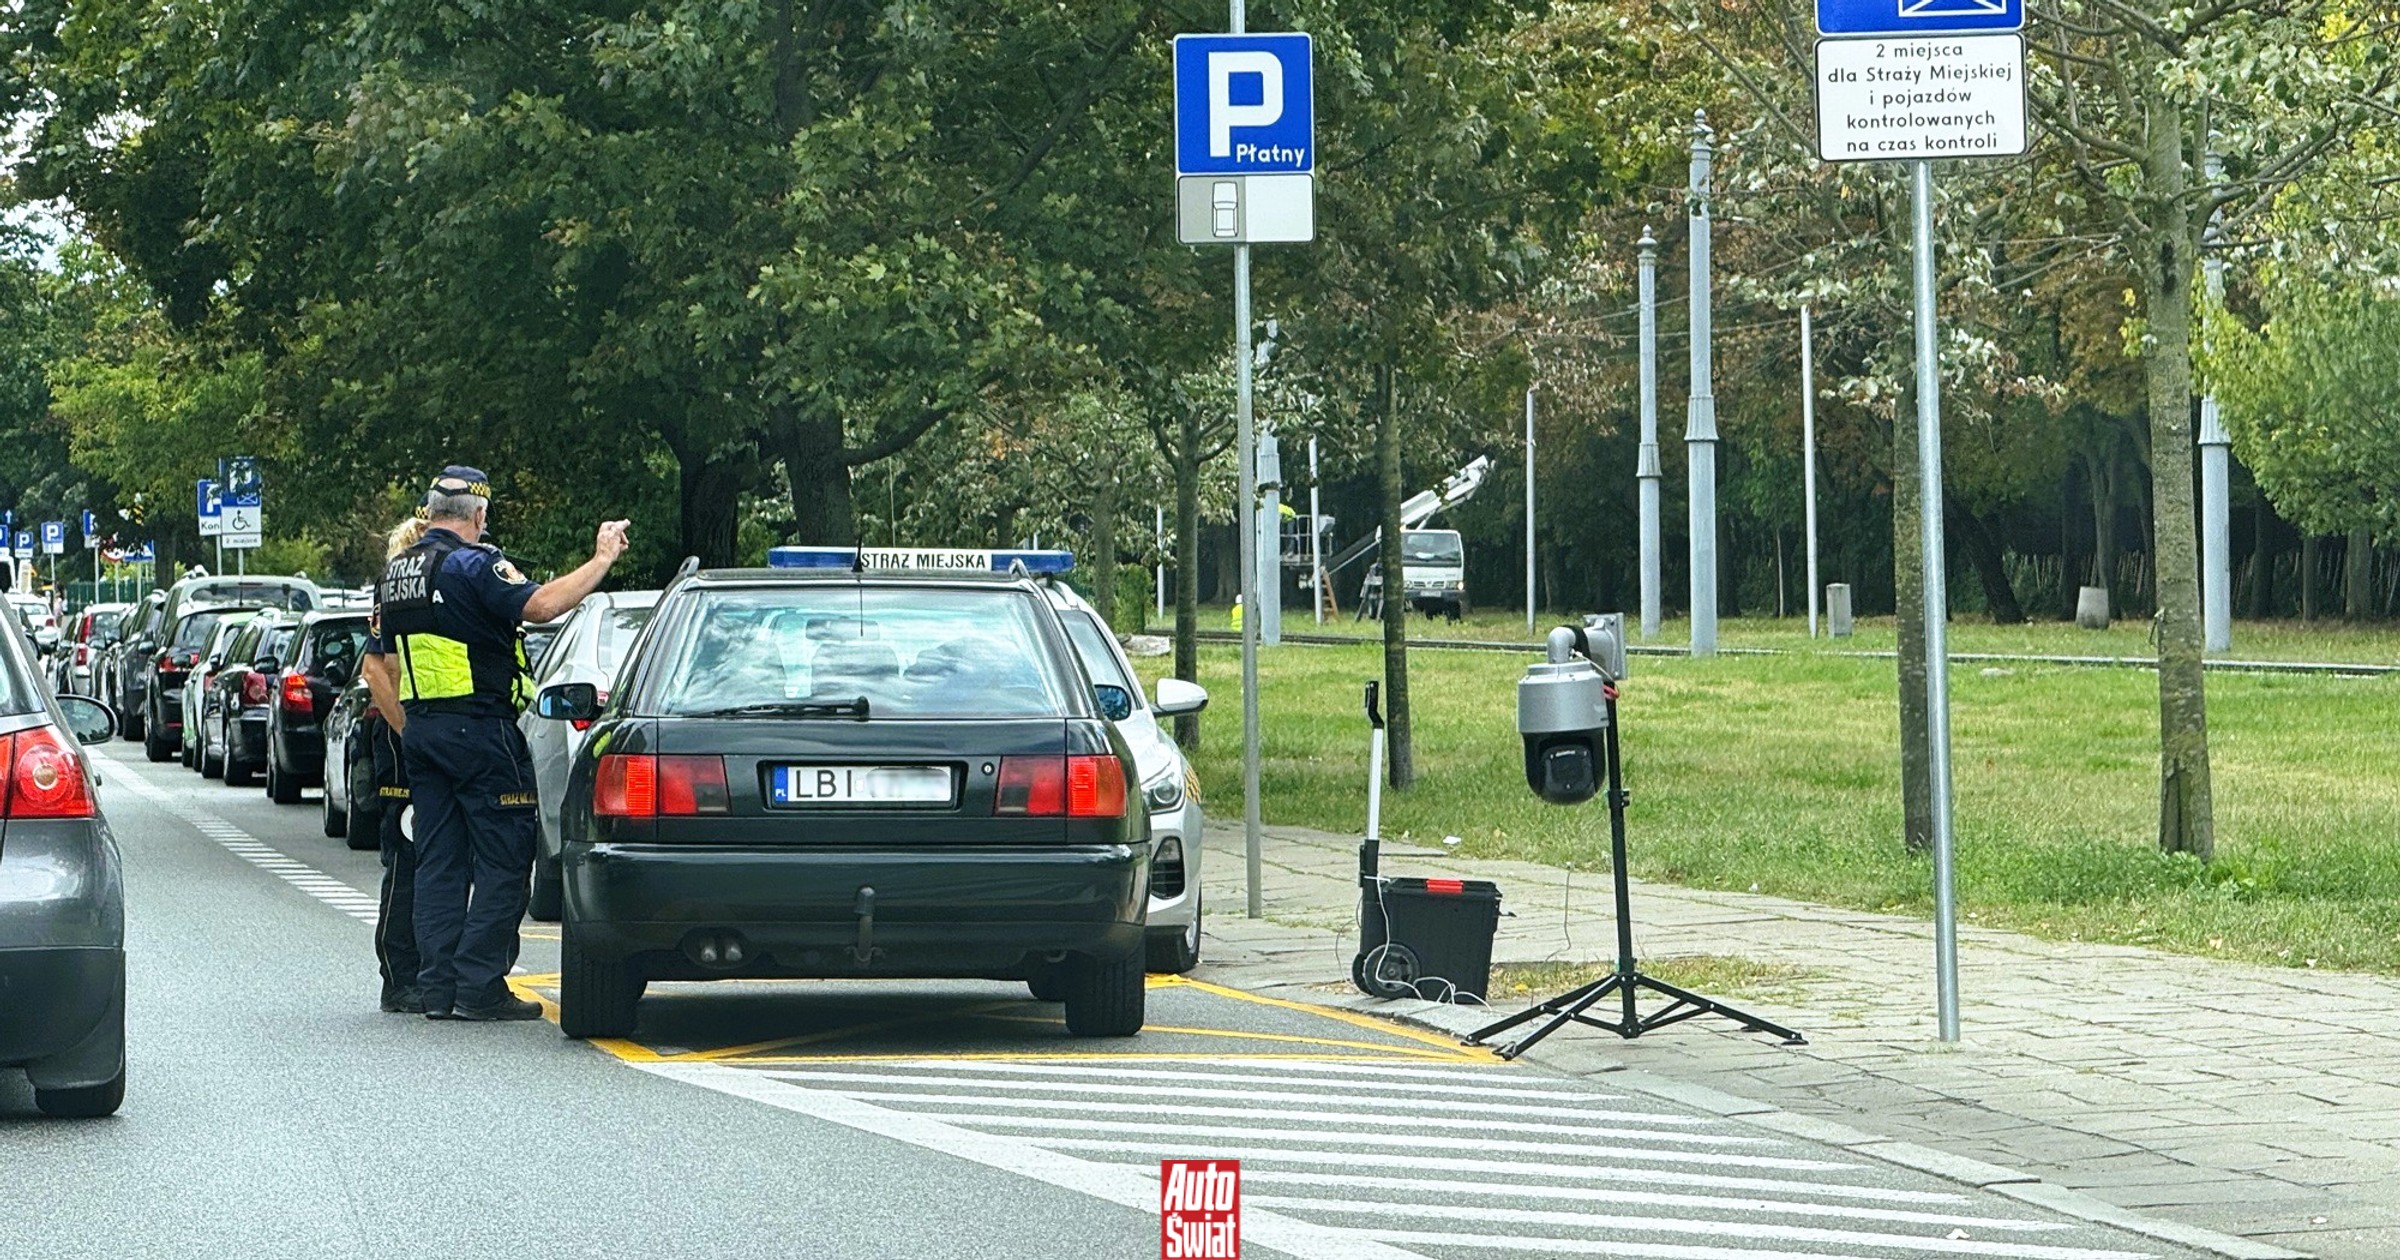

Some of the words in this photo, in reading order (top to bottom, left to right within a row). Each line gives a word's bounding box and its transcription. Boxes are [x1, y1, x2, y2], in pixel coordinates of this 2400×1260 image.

[1876, 43, 1885, 58] 2
[1893, 42, 1963, 61] miejsca
[1828, 68, 1857, 83] dla
[1866, 65, 1921, 84] Straży
[1930, 63, 2012, 82] Miejskiej
[1208, 51, 1284, 157] P
[1869, 90, 1874, 105] i
[1883, 87, 1972, 109] pojazdów
[1846, 110, 1995, 130] kontrolowanych
[1846, 140, 1869, 152] na
[1877, 139, 1916, 152] czas
[1925, 132, 1997, 150] kontroli
[1236, 143, 1305, 168] Płatny
[916, 553, 986, 569] MIEJSKA
[775, 788, 787, 798] PL
